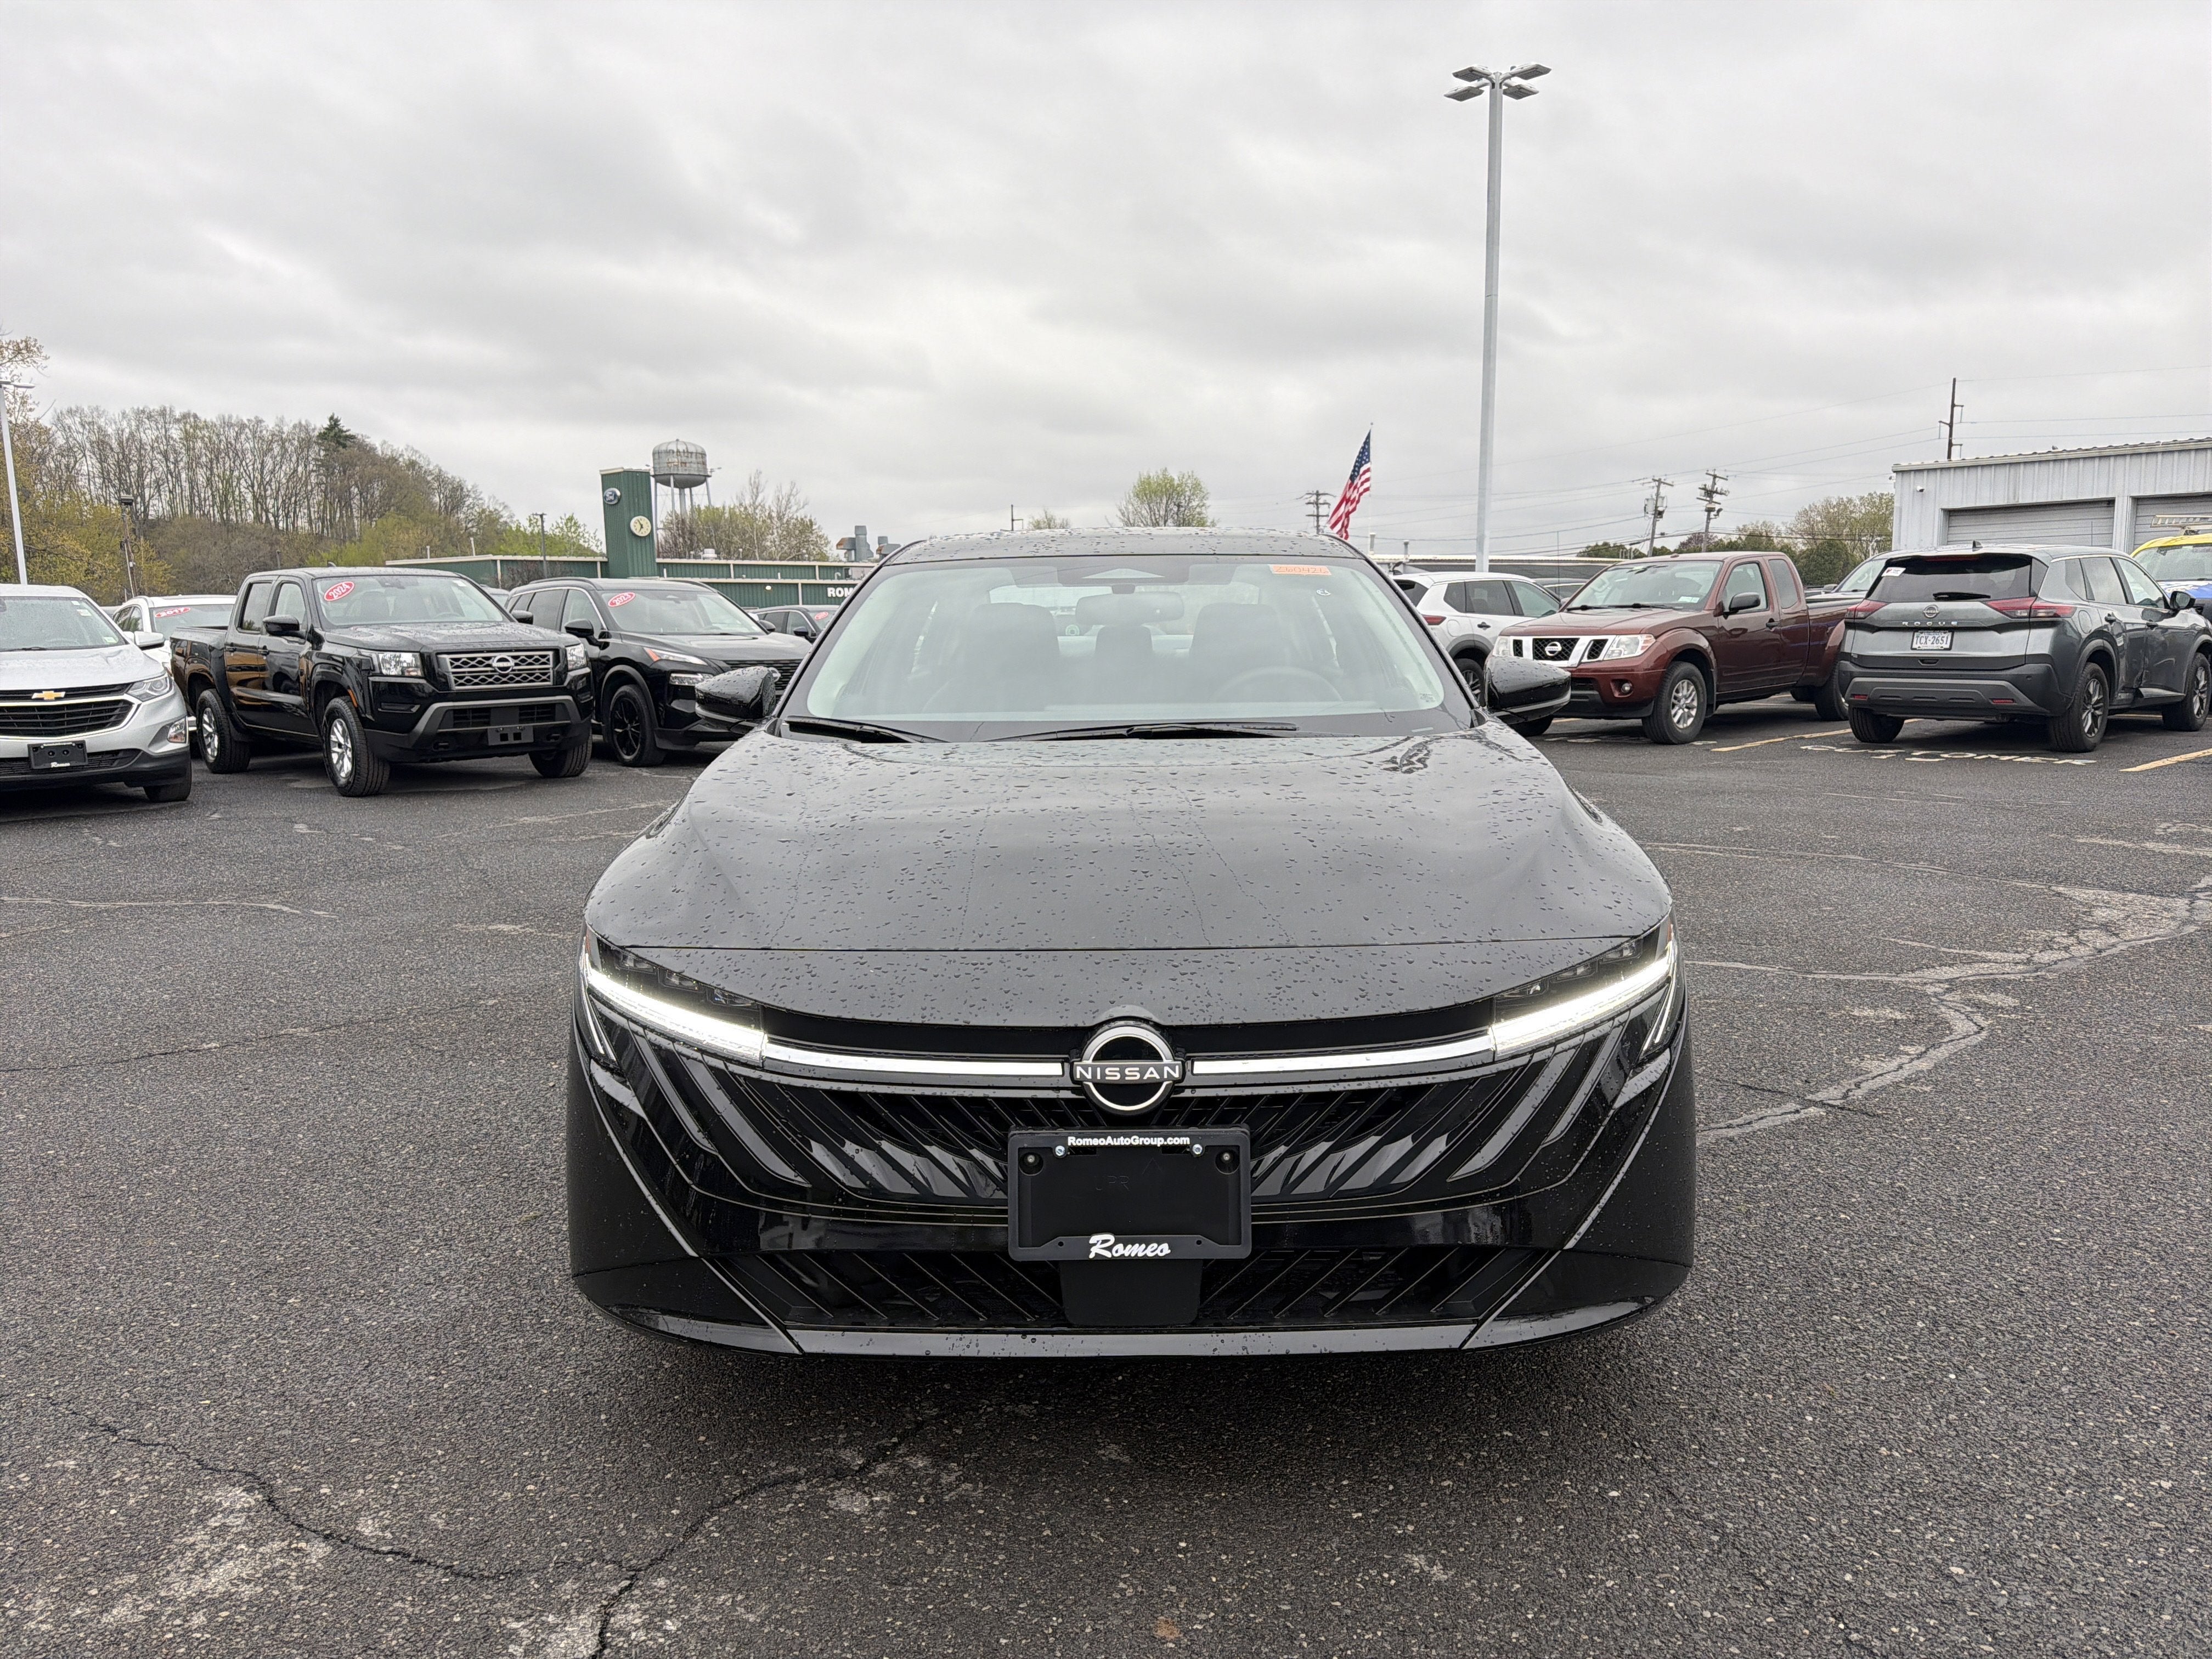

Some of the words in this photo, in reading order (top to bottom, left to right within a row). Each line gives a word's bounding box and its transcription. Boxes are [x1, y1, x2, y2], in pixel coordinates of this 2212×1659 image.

[1915, 634, 1950, 645] TCX-2651
[1076, 1065, 1180, 1080] NISSAN
[1068, 1135, 1190, 1147] RomeoAutoGroup.com
[1088, 1233, 1171, 1259] Romeo
